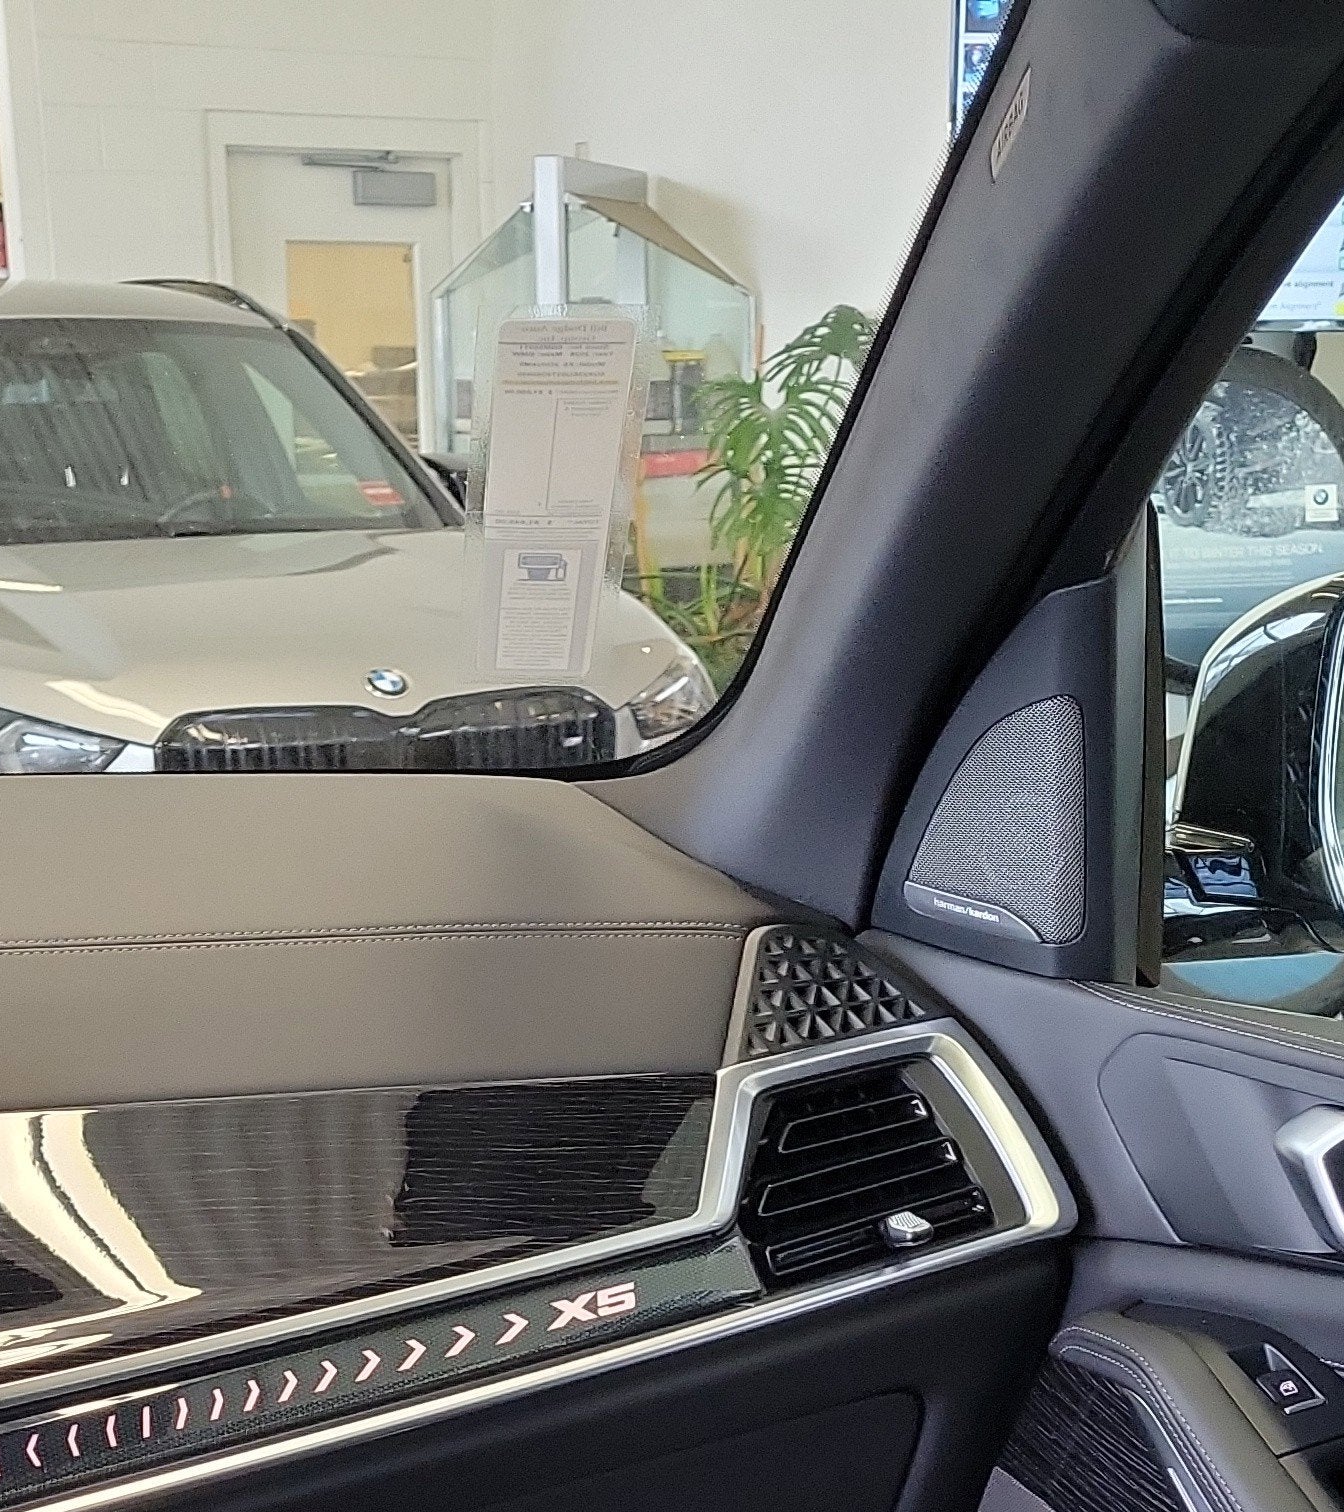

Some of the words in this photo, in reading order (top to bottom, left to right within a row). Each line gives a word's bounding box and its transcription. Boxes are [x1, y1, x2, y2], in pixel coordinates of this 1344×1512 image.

[1275, 543, 1323, 556] SEASON
[933, 896, 1001, 923] harman/kardon
[545, 1281, 636, 1332] X5
